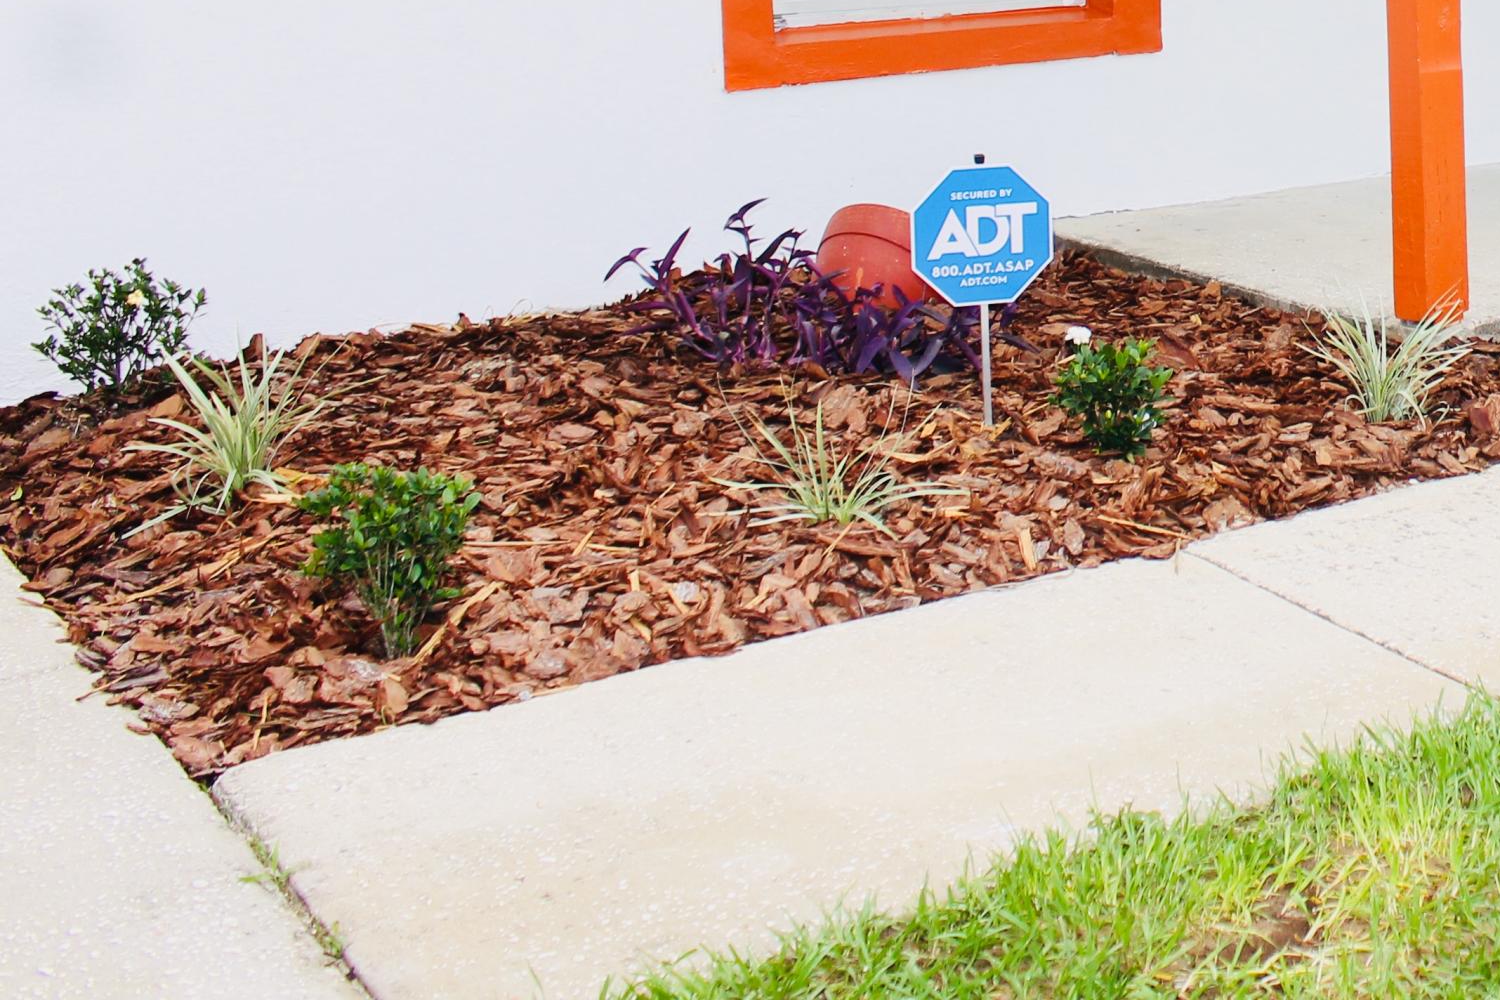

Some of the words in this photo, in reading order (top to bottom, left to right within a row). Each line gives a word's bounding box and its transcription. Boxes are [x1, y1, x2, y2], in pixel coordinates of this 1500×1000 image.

[950, 191, 997, 200] SECURED
[999, 188, 1013, 197] BY
[927, 202, 1037, 261] ADT
[931, 259, 1034, 278] 800.ADT.ASAP
[960, 275, 1008, 287] ADT.COM
